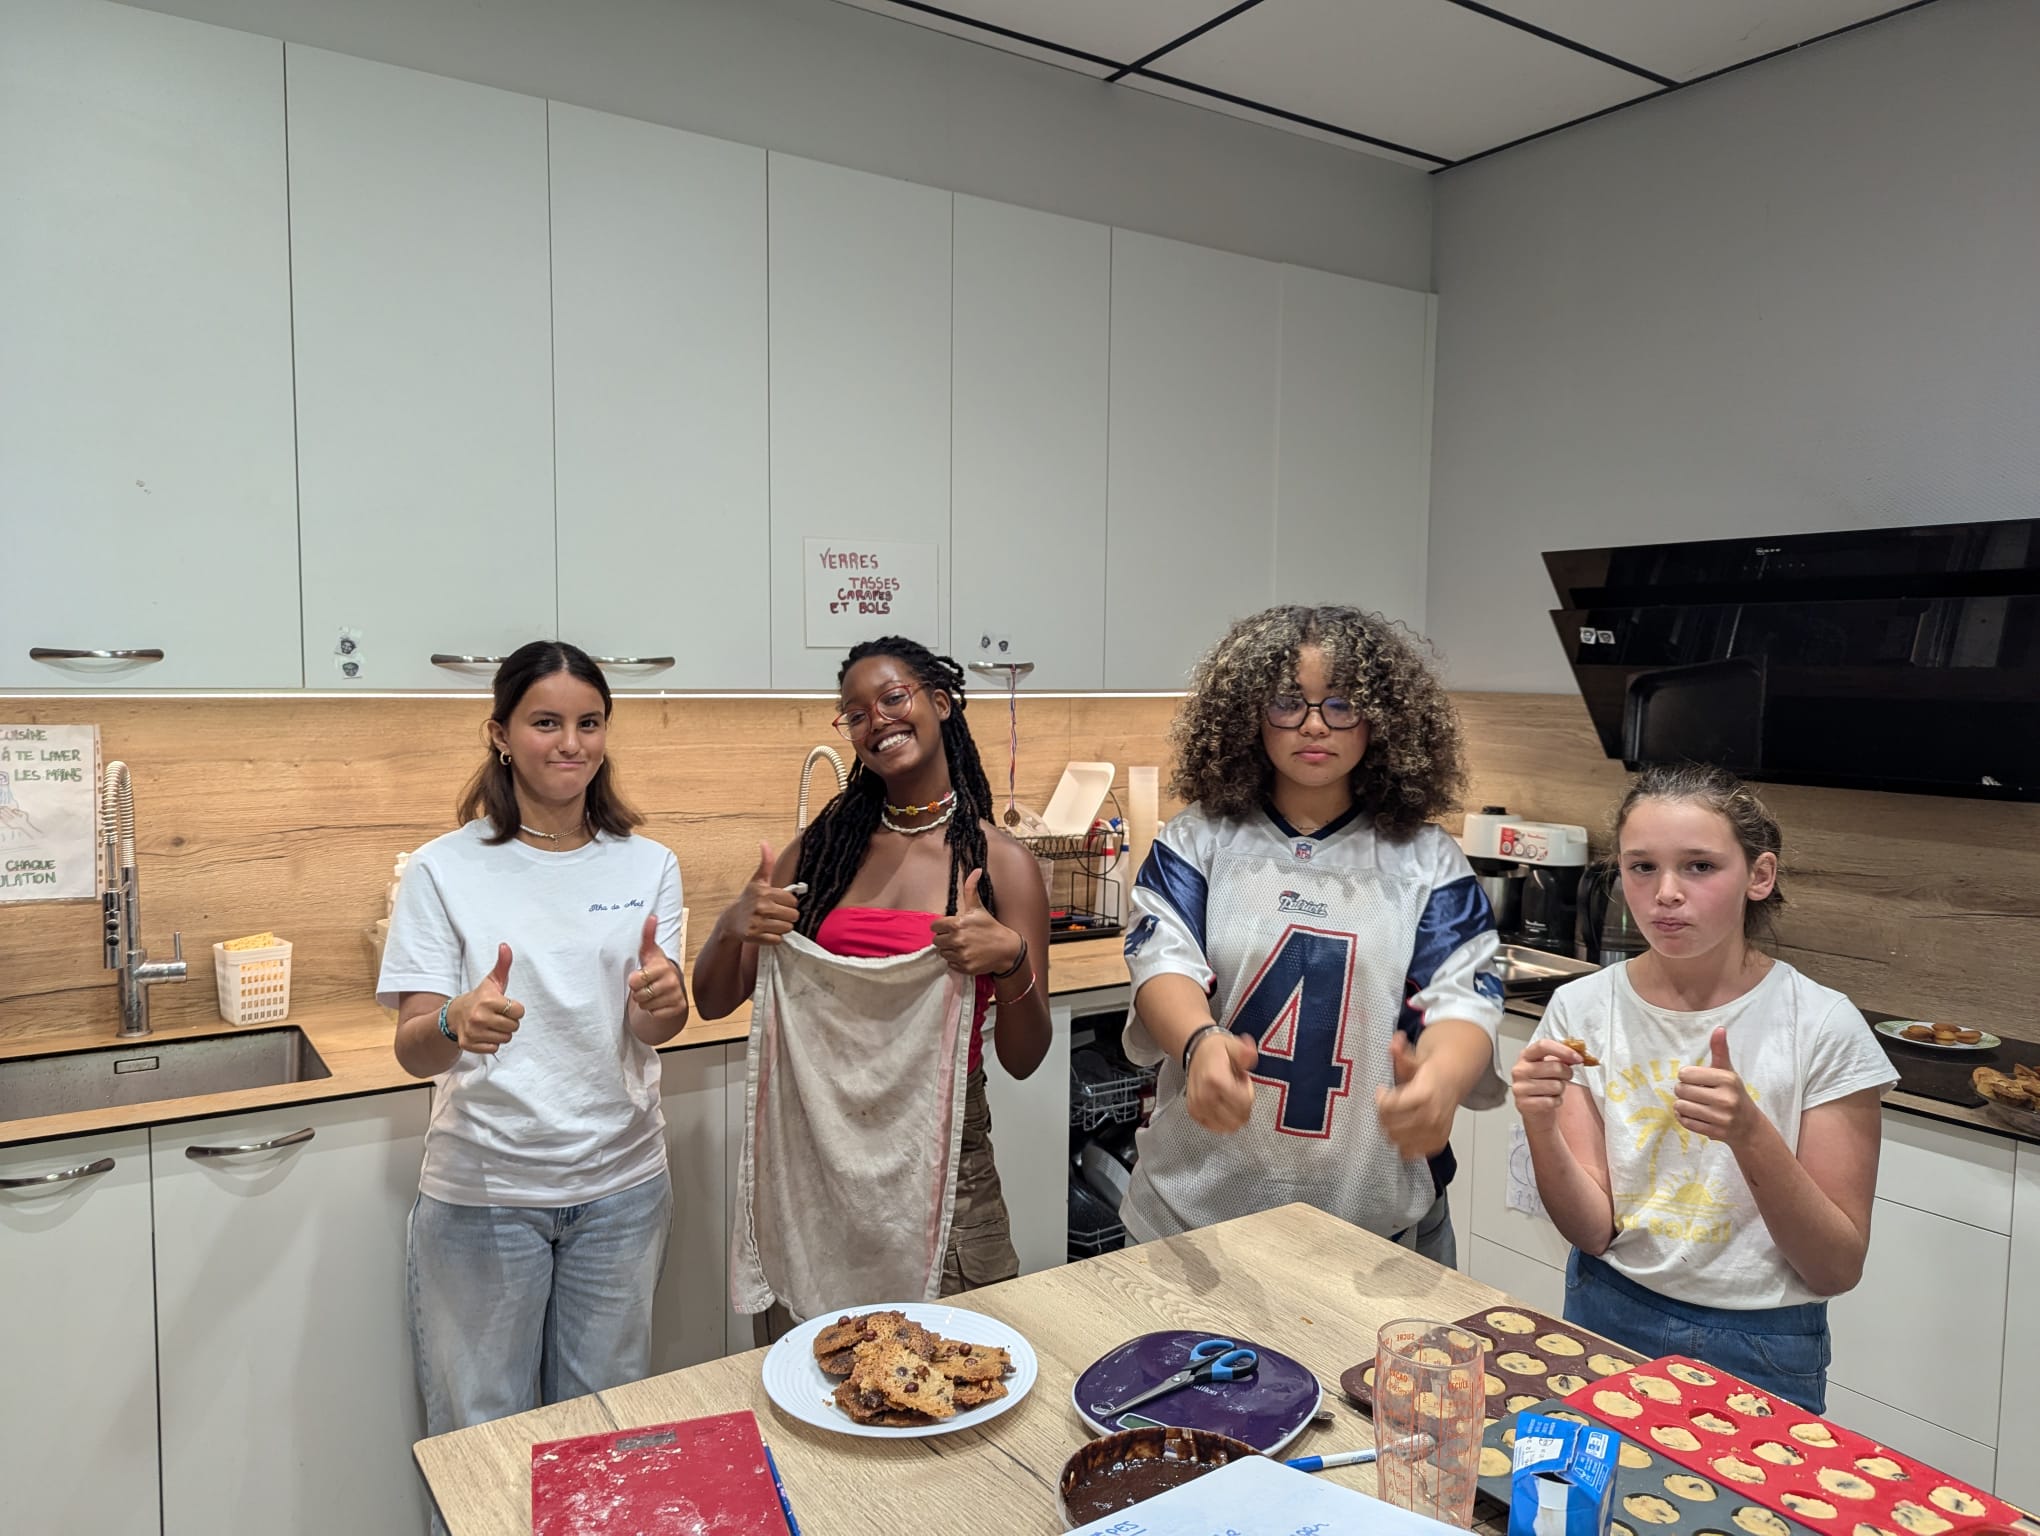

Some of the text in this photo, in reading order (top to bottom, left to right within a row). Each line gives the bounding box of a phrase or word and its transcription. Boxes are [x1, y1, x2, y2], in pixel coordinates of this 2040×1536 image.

[820, 547, 879, 569] VERRES
[848, 576, 900, 591] TASSES
[830, 601, 890, 615] ET BOLS
[15, 750, 35, 761] TE
[41, 749, 82, 762] LAVER
[14, 768, 83, 782] LES MAINS
[5, 859, 56, 872] CHAQUE
[1225, 923, 1357, 1139] 4
